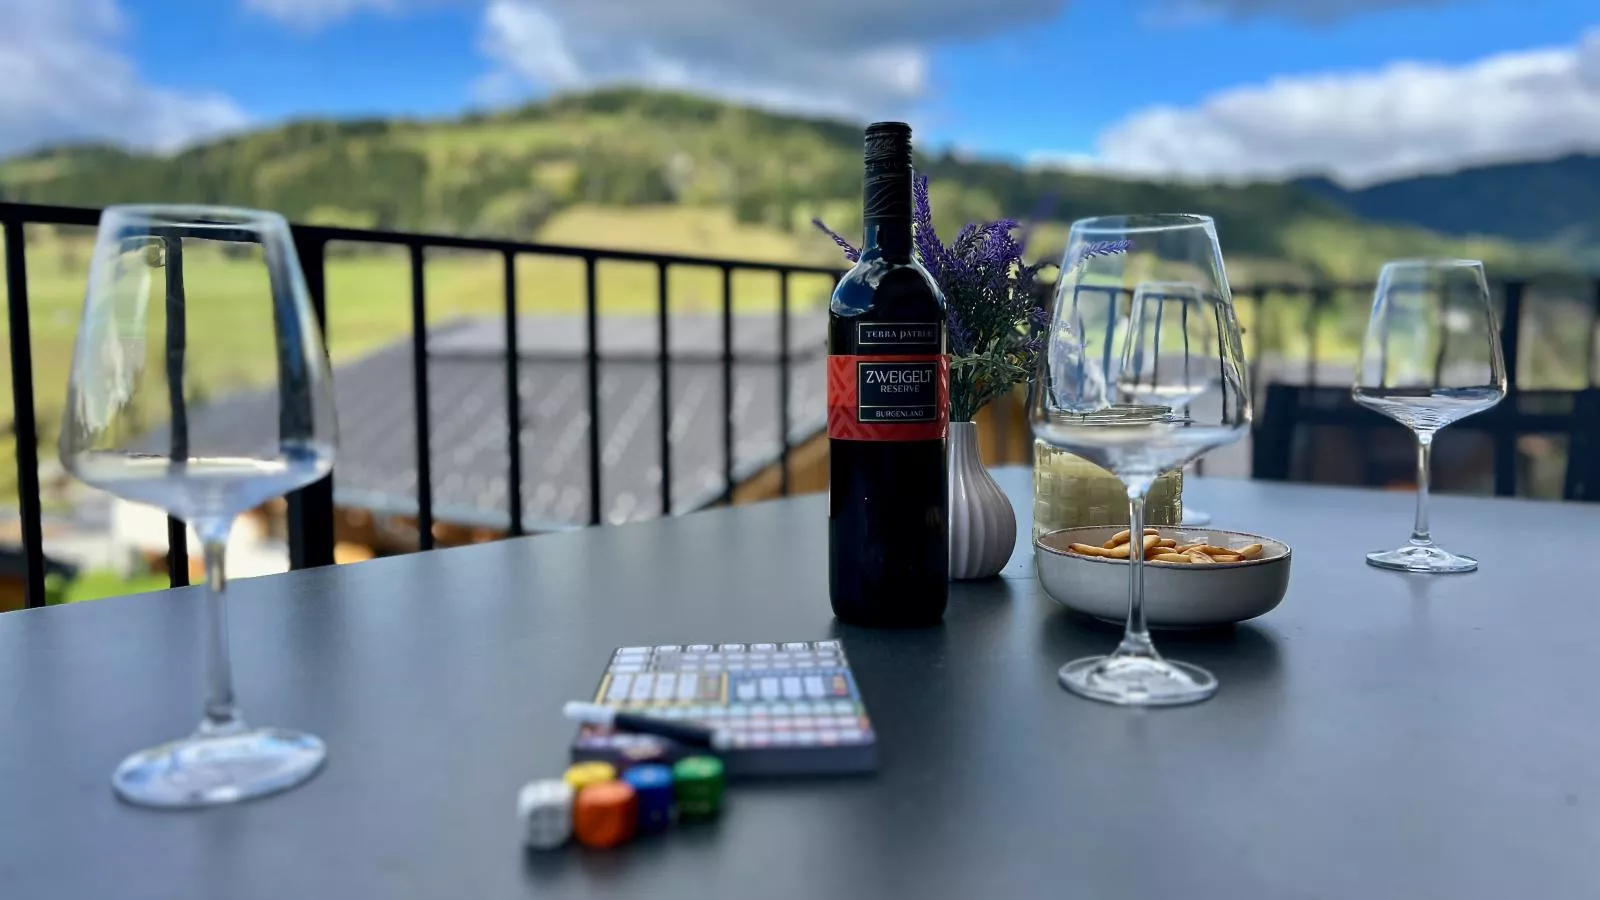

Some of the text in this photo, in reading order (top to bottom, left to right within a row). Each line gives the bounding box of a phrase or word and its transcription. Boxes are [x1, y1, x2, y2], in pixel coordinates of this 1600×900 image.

[866, 330, 897, 338] TERRA
[866, 370, 932, 383] ZWEIGELT
[880, 384, 920, 393] RESERVE
